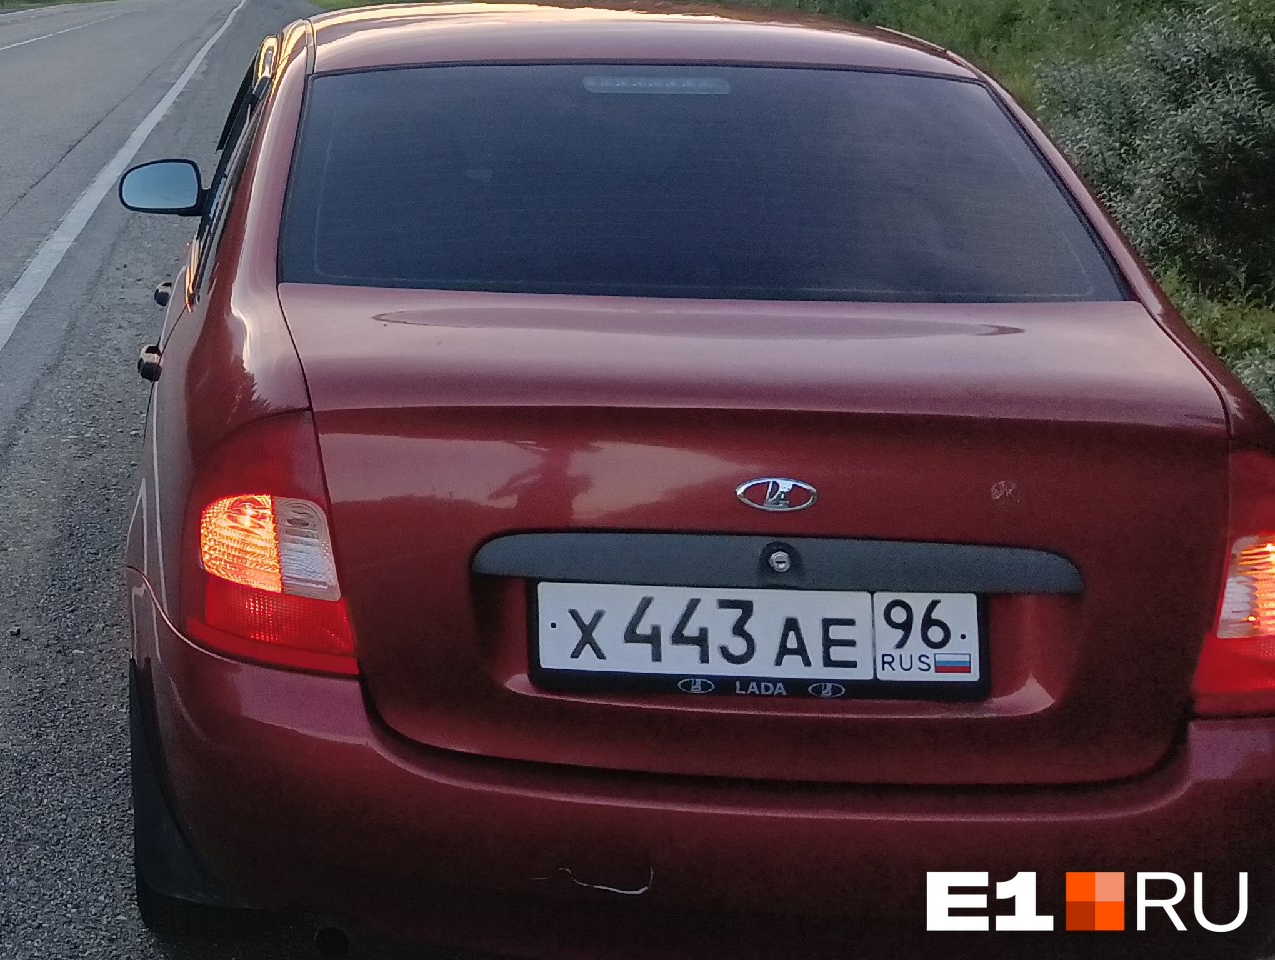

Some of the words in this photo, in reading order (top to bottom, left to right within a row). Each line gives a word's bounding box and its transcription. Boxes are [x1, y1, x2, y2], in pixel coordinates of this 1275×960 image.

[882, 599, 952, 650] 96
[881, 653, 932, 672] RUS
[735, 680, 788, 697] LADA
